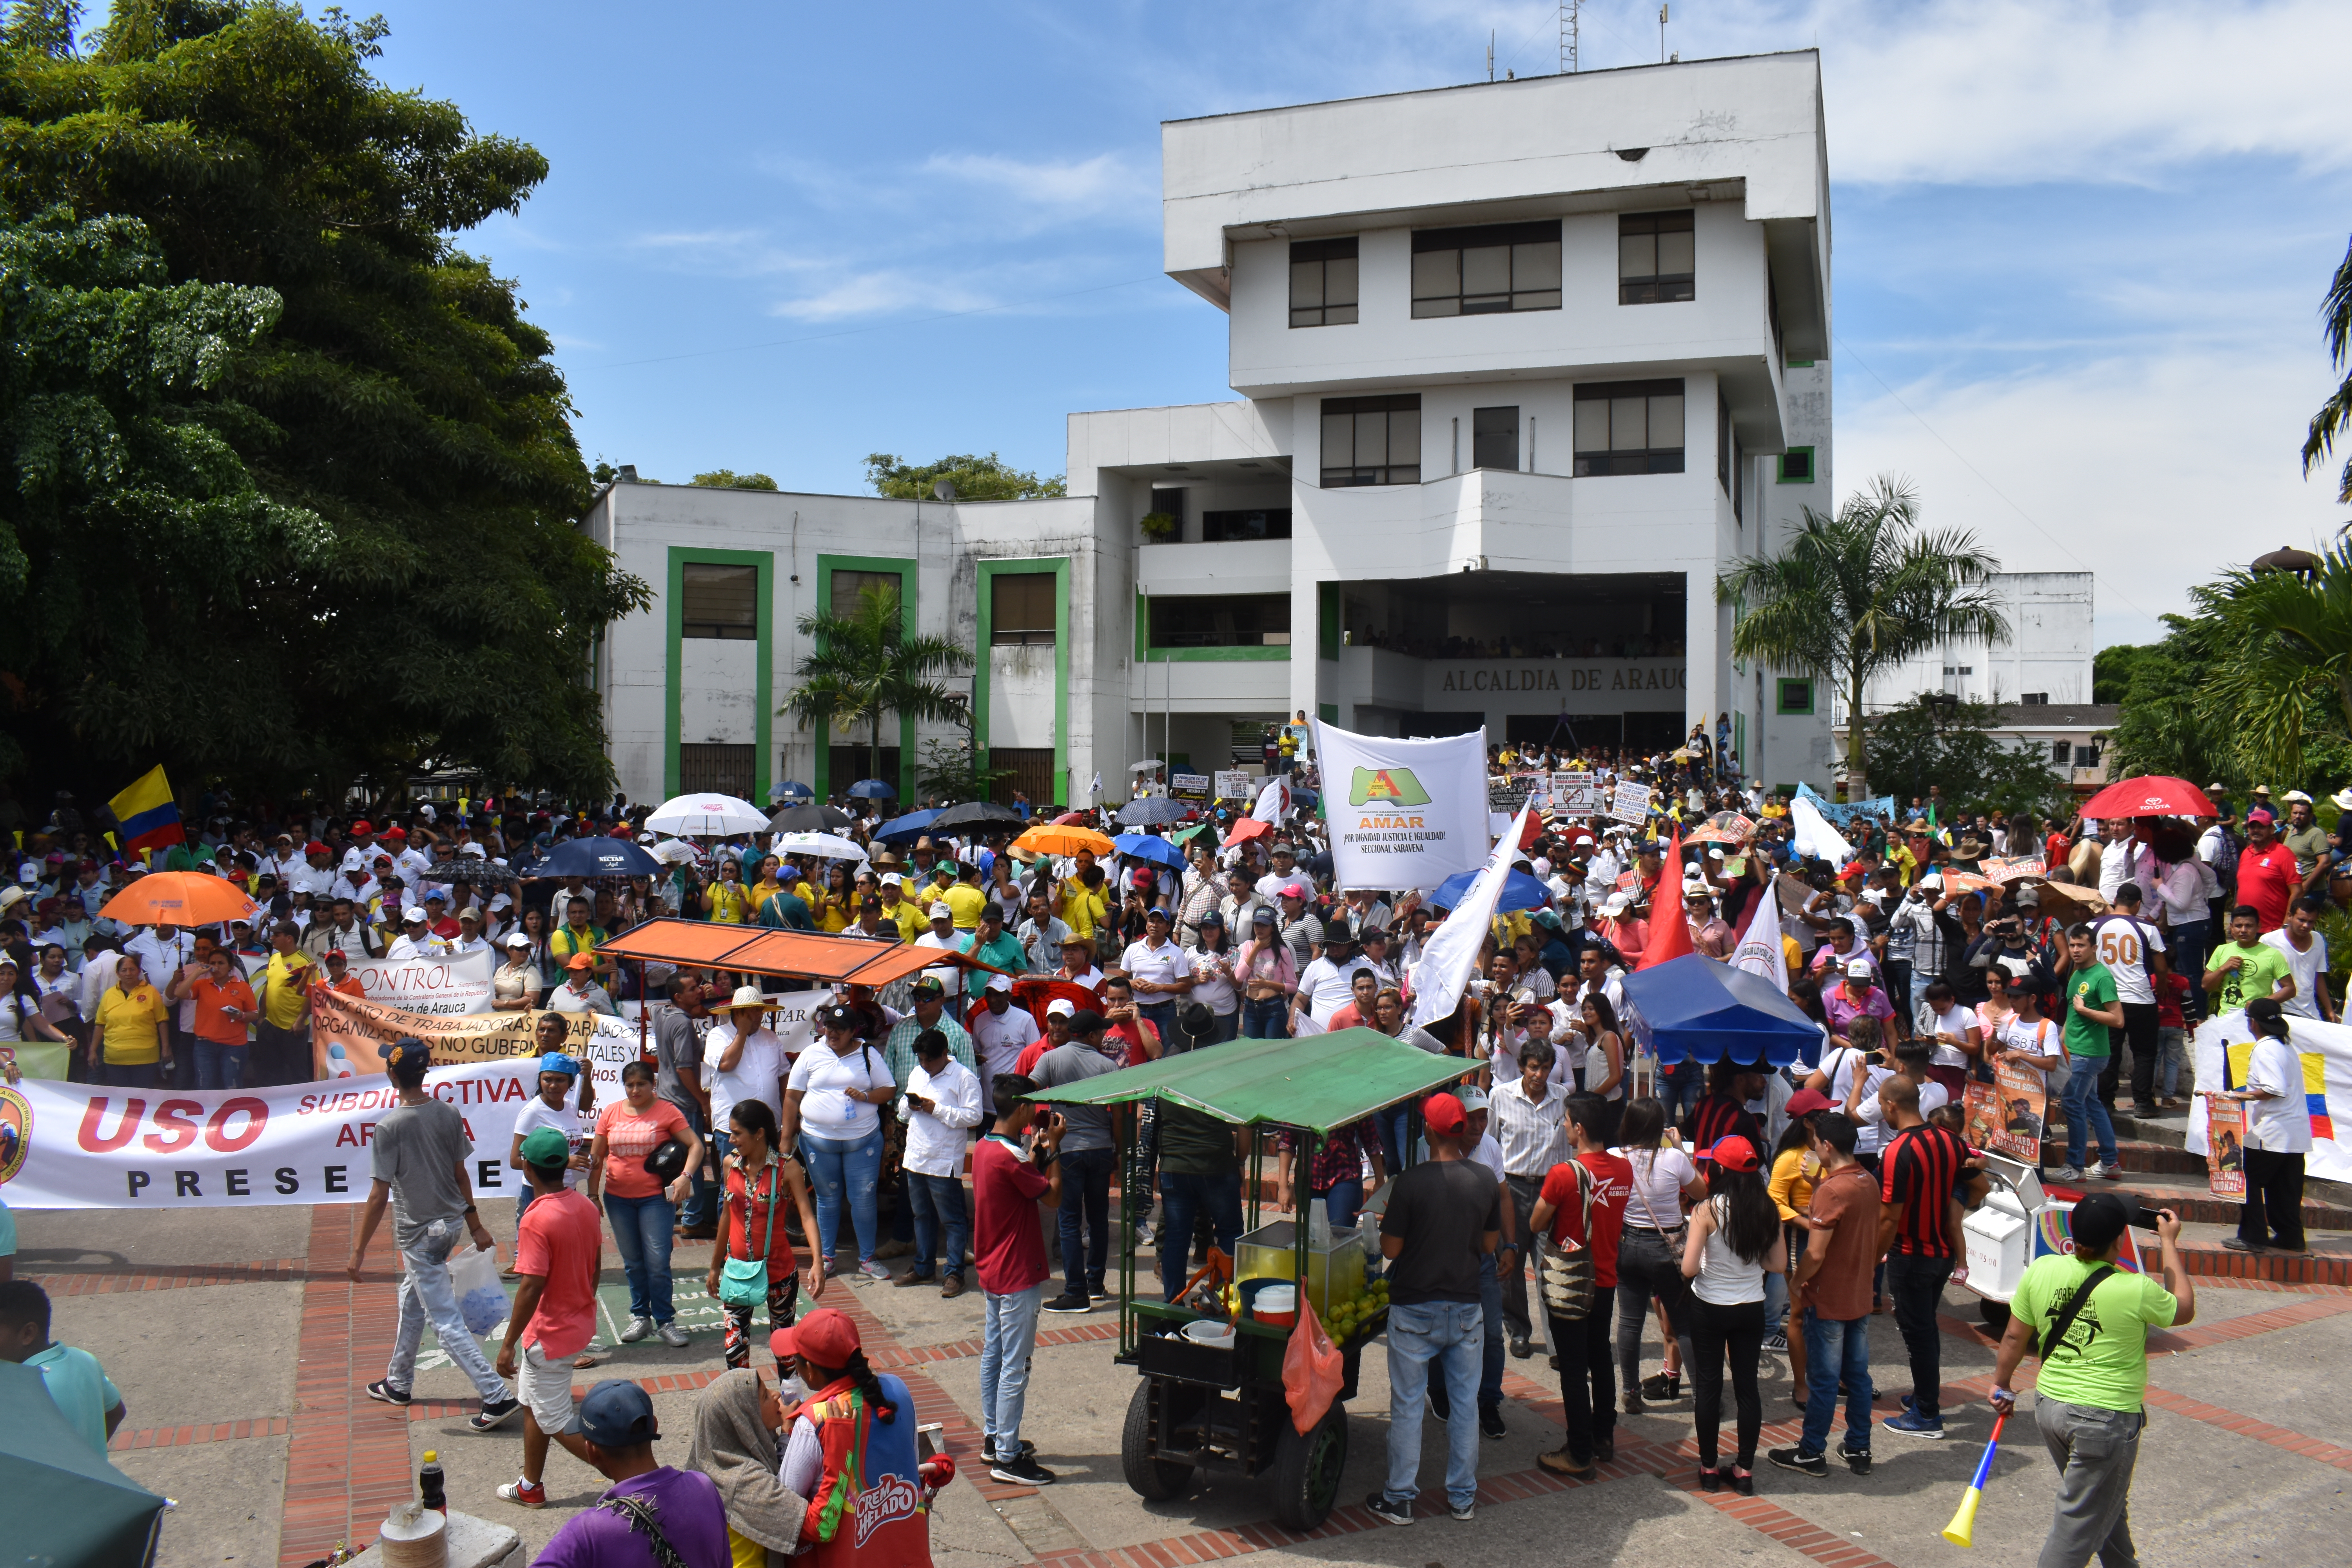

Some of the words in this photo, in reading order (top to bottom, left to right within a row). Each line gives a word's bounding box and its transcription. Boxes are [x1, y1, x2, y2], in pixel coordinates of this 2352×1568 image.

[1443, 669, 1560, 691] ALCALDIA
[1572, 669, 1602, 690] DE
[1611, 668, 1687, 690] ARAUC
[1359, 817, 1425, 829] AMAR
[1613, 812, 1643, 823] COLOMBIA
[1343, 834, 1354, 844] ¡POR
[1356, 833, 1380, 842] DIGNIDAD
[1382, 832, 1408, 841] JUSTICIA
[1409, 832, 1412, 841] E
[1414, 831, 1446, 841] IGUALDAD!
[1361, 844, 1392, 854] SECCIONAL
[1394, 844, 1424, 853] SARAVENA
[2102, 933, 2138, 965] 50
[920, 977, 934, 986] AT
[364, 994, 396, 1002] Trabajadores
[417, 1005, 429, 1014] de
[430, 1002, 466, 1014] Arauca
[385, 1012, 411, 1025] DE
[414, 1017, 532, 1033] TRABAJADORAS
[441, 1036, 466, 1052] NO
[629, 1047, 637, 1062] Y
[2013, 1071, 2025, 1080] VIDA
[2032, 1076, 2041, 1084] PAZ
[2001, 1080, 2021, 1090] JUSTICIA
[2022, 1083, 2042, 1094] SOCIAL
[7, 1092, 30, 1122] INDUSTRIA
[1973, 1102, 1984, 1110] CON
[78, 1097, 269, 1153] USO
[336, 1118, 475, 1148] ARA
[2007, 1132, 2013, 1141] EL
[2014, 1134, 2031, 1146] PARO
[128, 1160, 502, 1198] PRESEE
[2225, 1172, 2239, 1181] PARO
[1966, 1247, 1976, 1257] CAR
[2053, 1288, 2067, 1301] POR
[857, 1479, 891, 1519] CREM
[858, 1488, 913, 1540] HELADO
